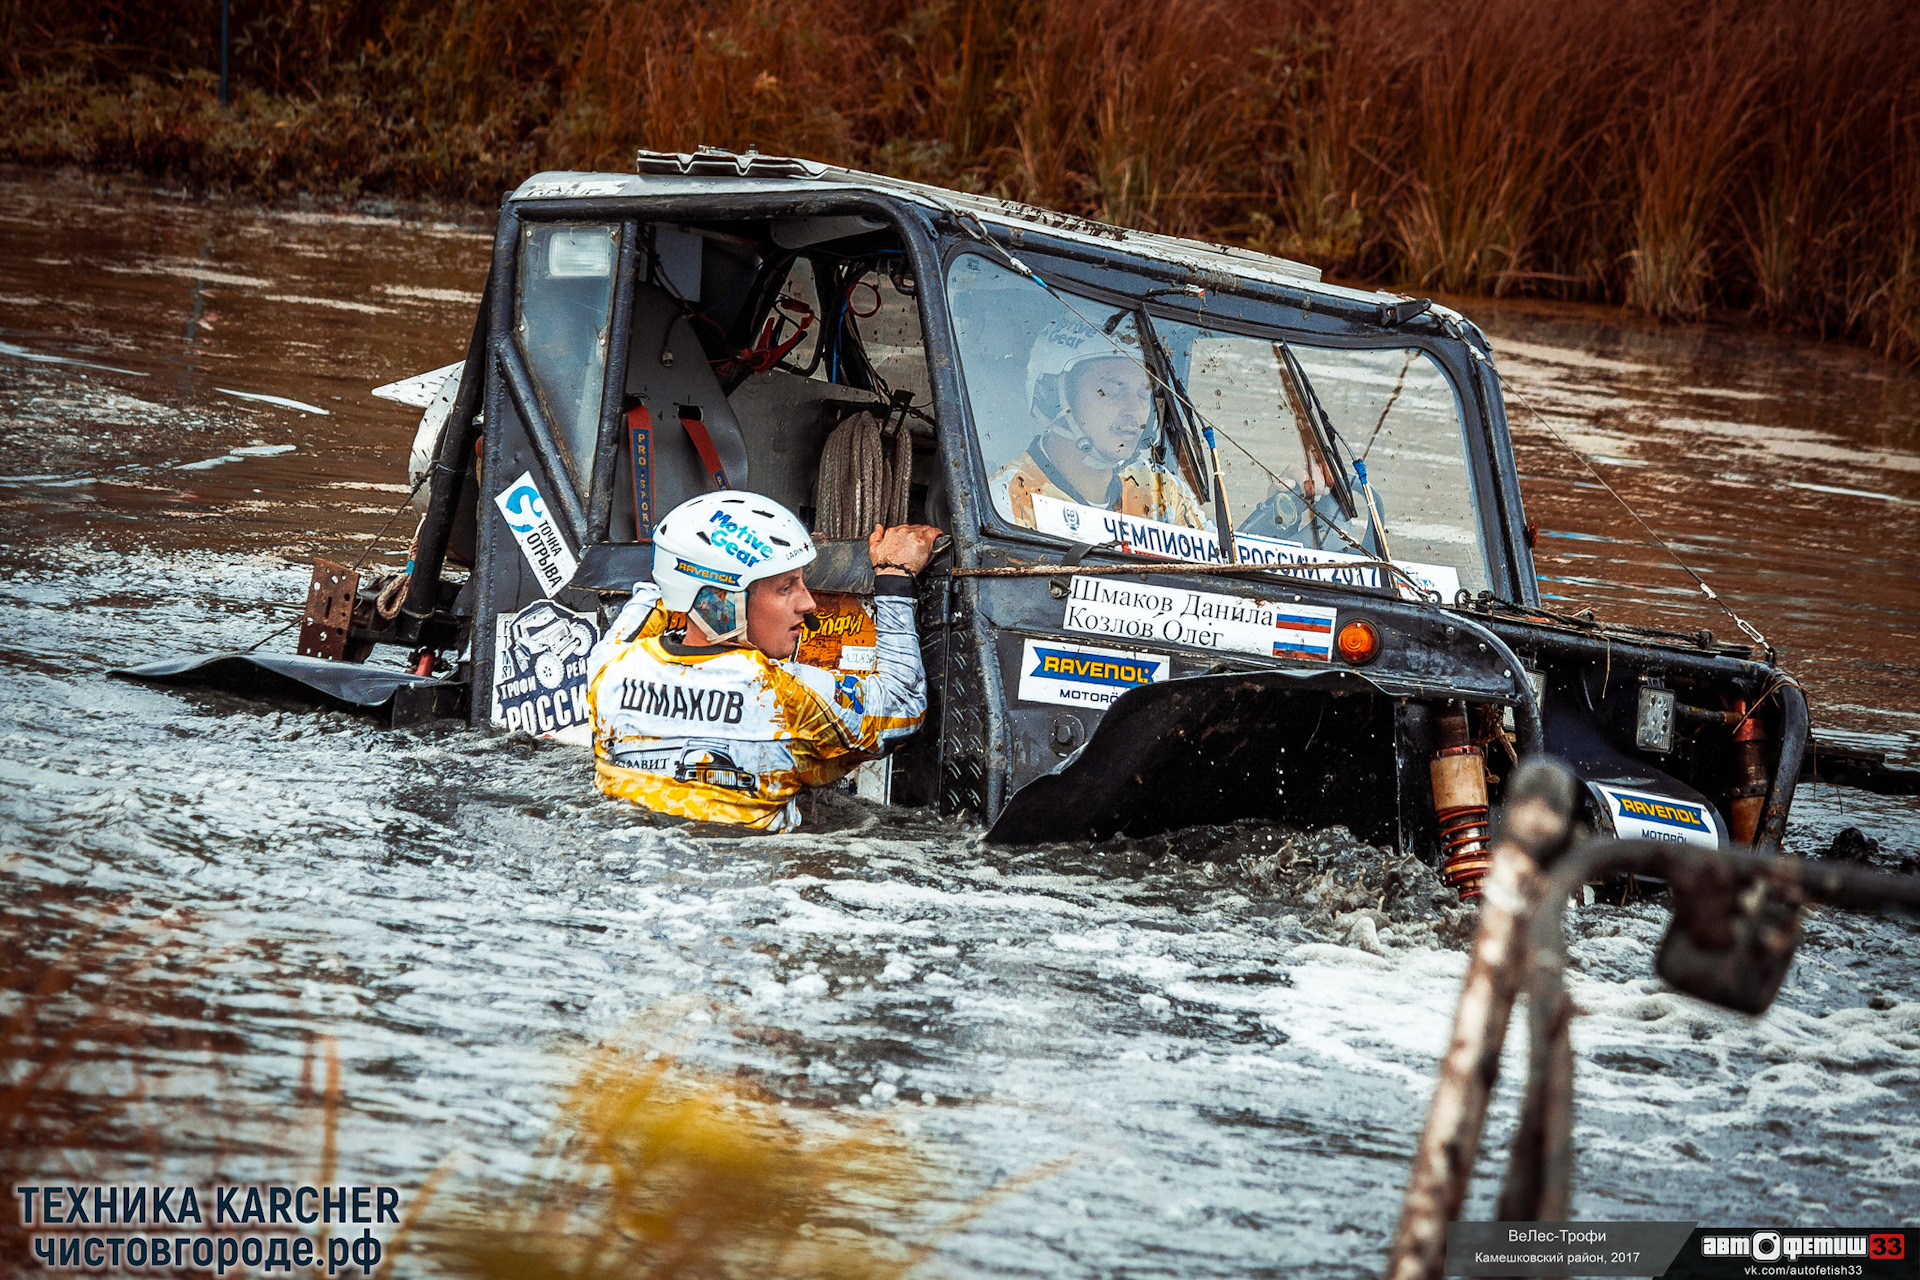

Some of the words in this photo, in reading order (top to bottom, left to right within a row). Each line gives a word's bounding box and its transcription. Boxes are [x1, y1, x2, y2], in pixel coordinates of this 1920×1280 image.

[538, 519, 562, 557] ТОЧКА
[709, 510, 773, 558] Motive
[711, 530, 760, 568] Gear
[1103, 517, 1222, 563] ЧЕМПИОНА
[1331, 559, 1377, 587] 2017
[526, 532, 563, 588] ОТРЫВА
[678, 562, 736, 584] RAVENOL
[1070, 578, 1173, 612] Шмаков
[1180, 594, 1274, 627] Данила
[1067, 606, 1154, 638] Козлов
[1163, 619, 1224, 647] Олег
[500, 676, 537, 700] ТРОФИ
[566, 657, 588, 679] РЕЙ
[1043, 655, 1150, 684] RAVENOL
[505, 683, 591, 736] РОССИ
[1059, 689, 1119, 705] MOTORÖ
[1620, 798, 1702, 825] RAVENOL
